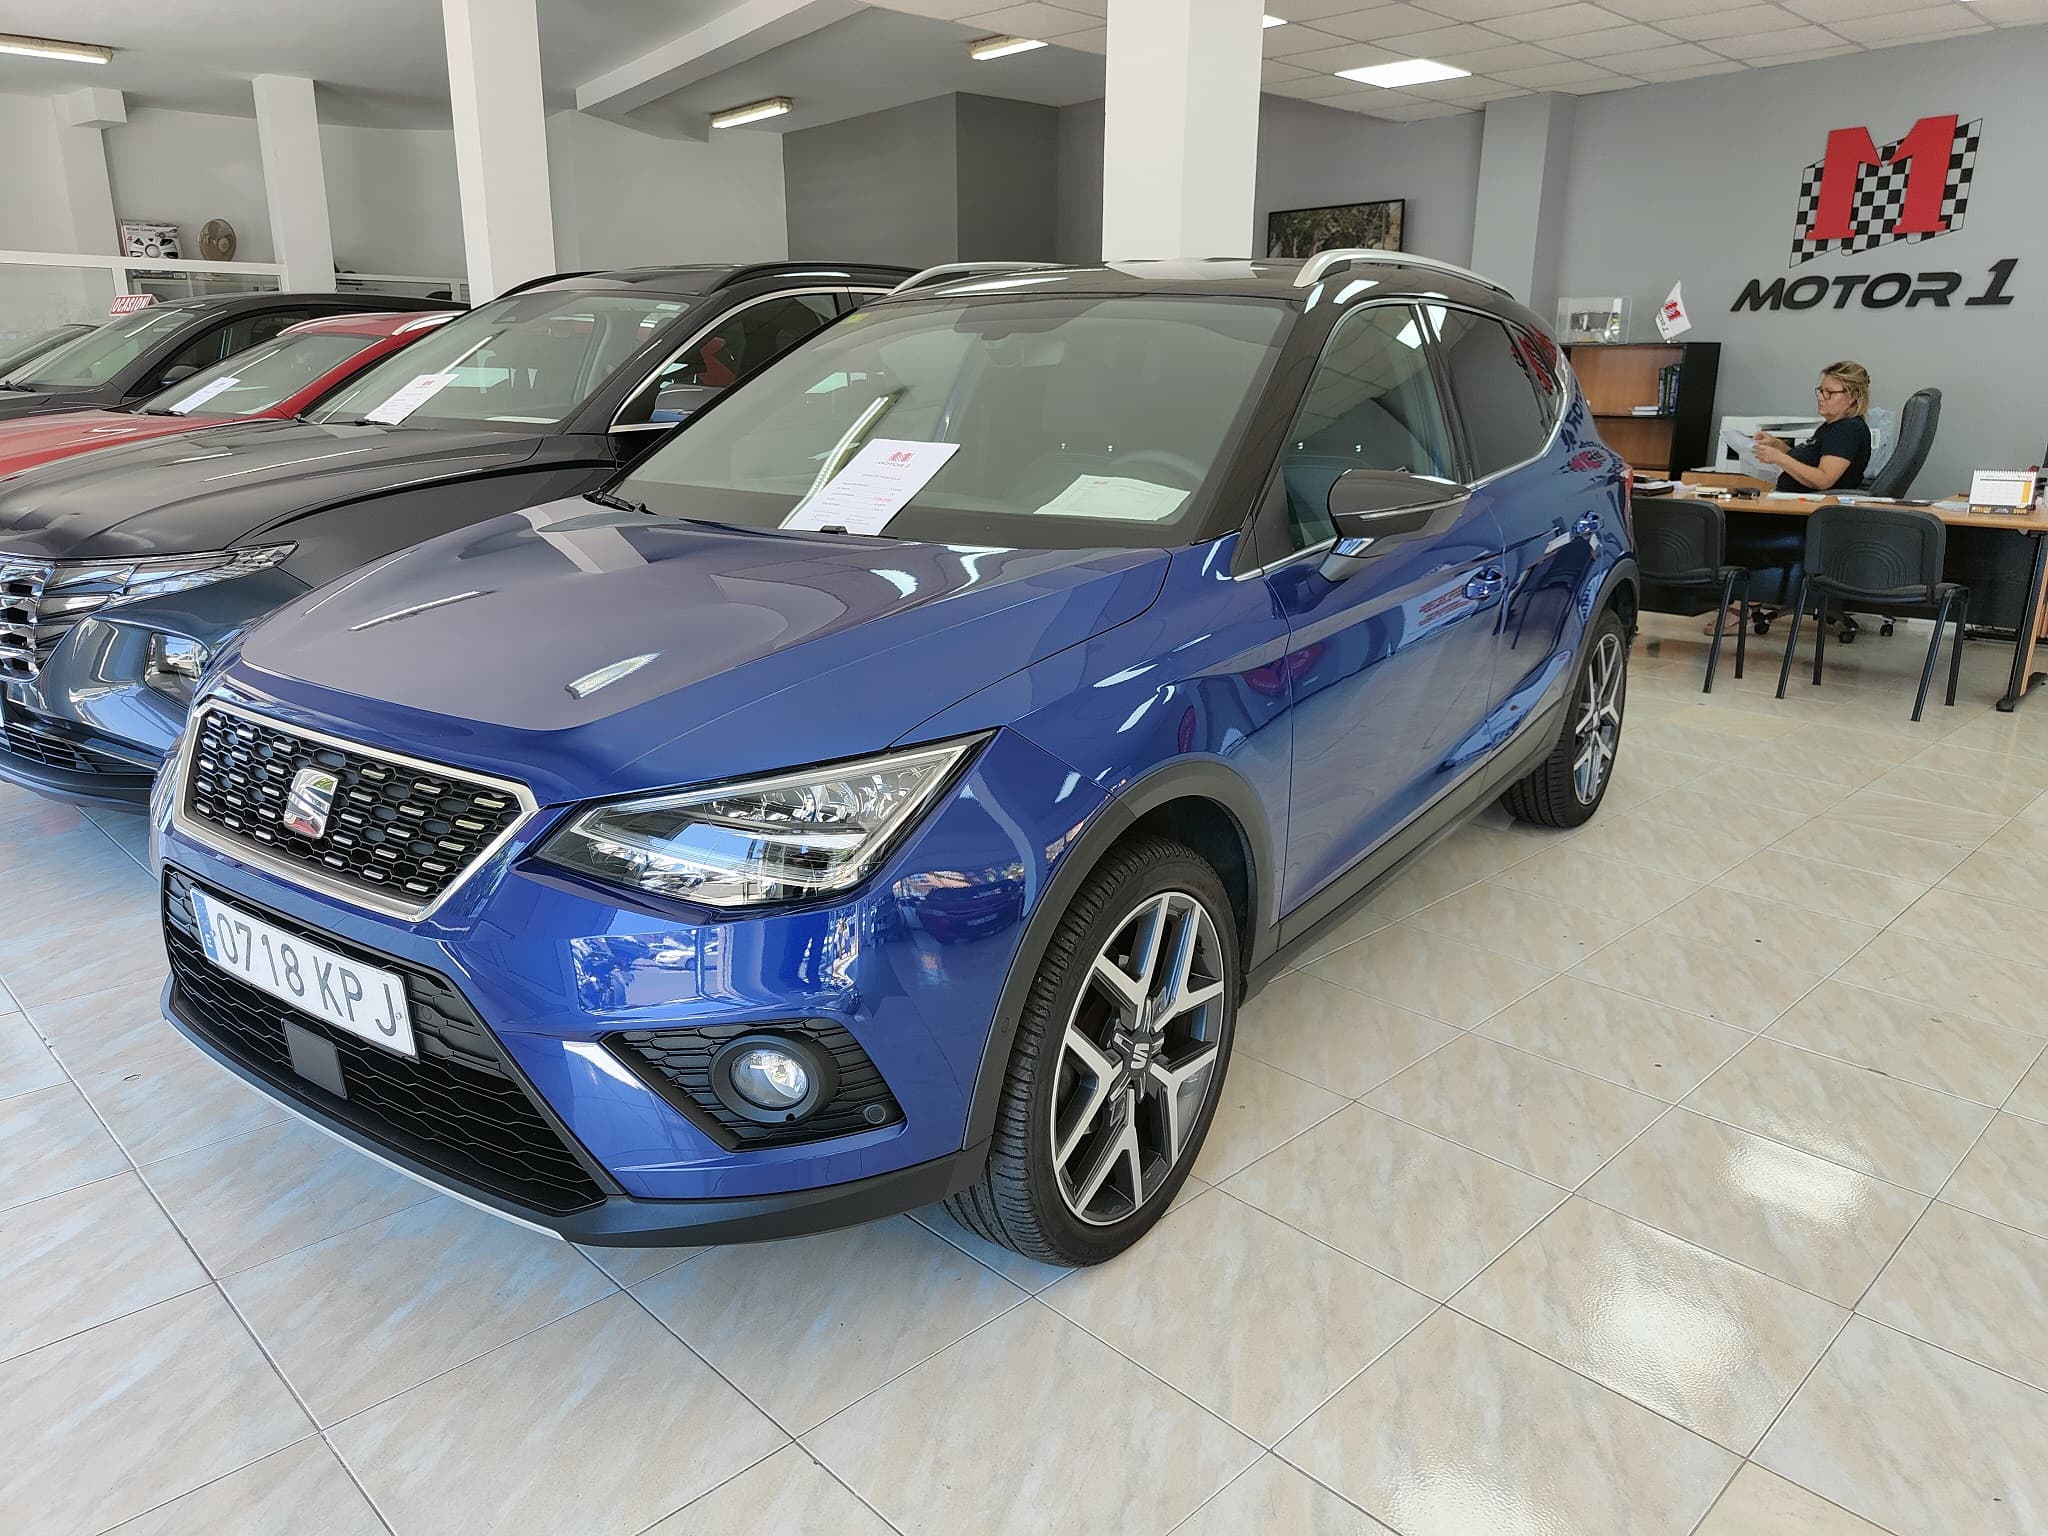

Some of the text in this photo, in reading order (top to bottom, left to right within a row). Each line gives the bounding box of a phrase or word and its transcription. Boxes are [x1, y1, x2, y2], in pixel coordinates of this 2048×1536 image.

[1730, 258, 2019, 313] MOTOR 1
[216, 912, 398, 1037] 0718 KPJ
